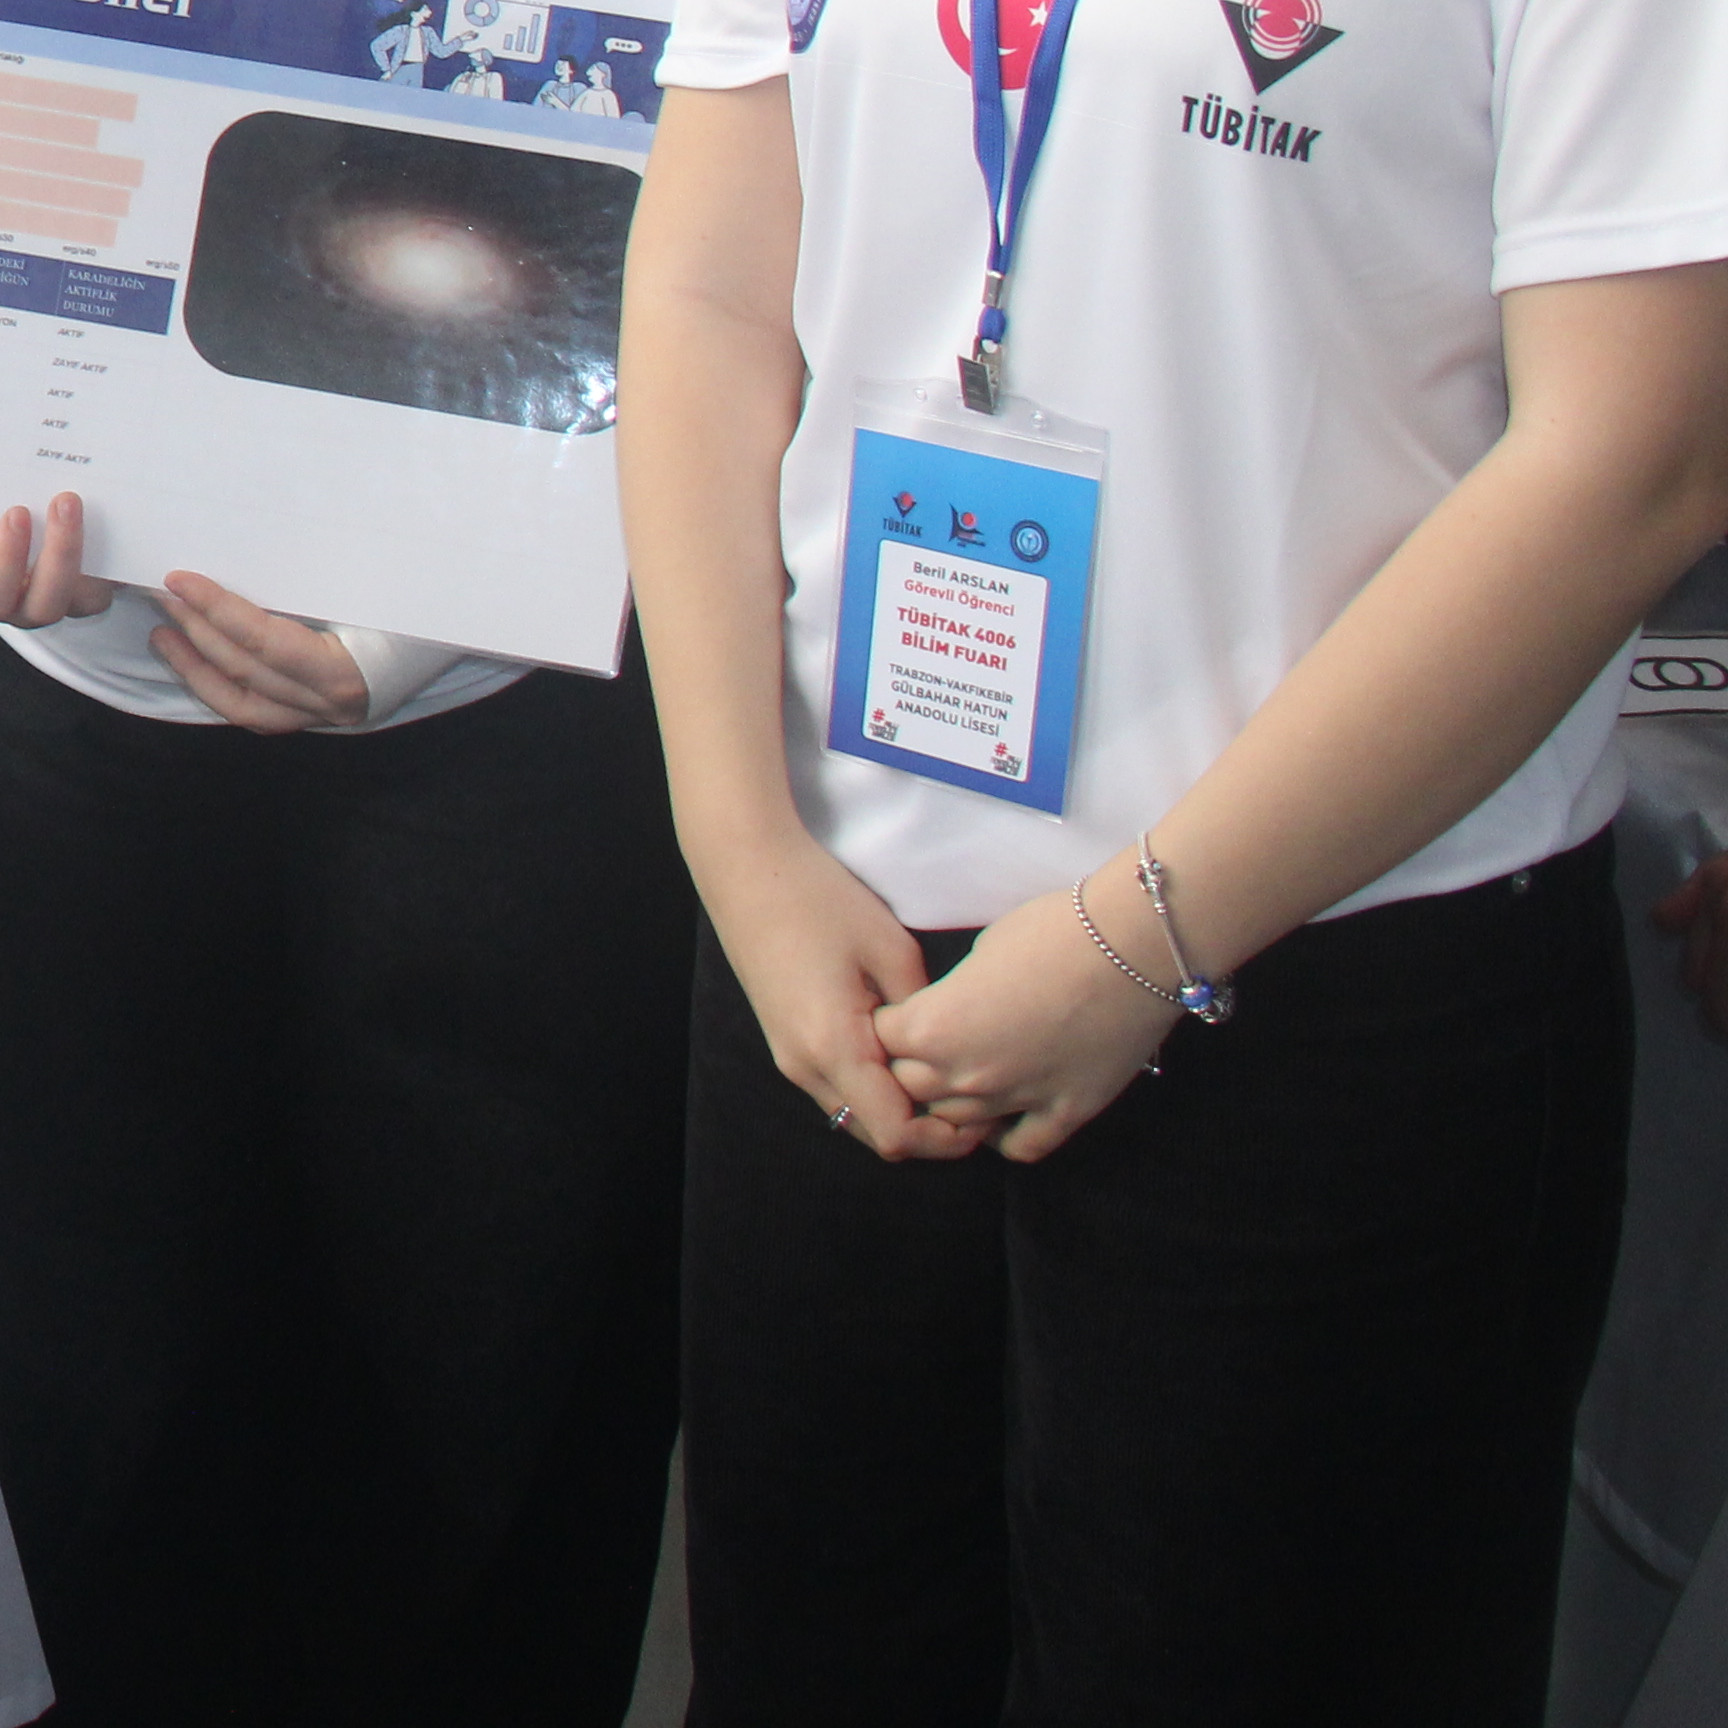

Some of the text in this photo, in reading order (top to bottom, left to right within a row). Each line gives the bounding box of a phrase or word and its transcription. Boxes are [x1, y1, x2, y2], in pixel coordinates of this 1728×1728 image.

[1182, 94, 1321, 162] TÜBİTAK
[883, 517, 922, 538] TÜBİTAK
[904, 578, 1014, 618] Görevli Öğrenci
[913, 561, 1009, 595] Beril ARSLAN
[898, 606, 1016, 649] TÜBİTAK 4006
[902, 631, 1008, 671] BİLİM FUARI
[889, 663, 1013, 705] TRABZON-VAKFIKEBİR
[891, 679, 1008, 721] GÜLBAHAR HATUN
[895, 699, 1000, 737] ANADOLU LİSESİ
